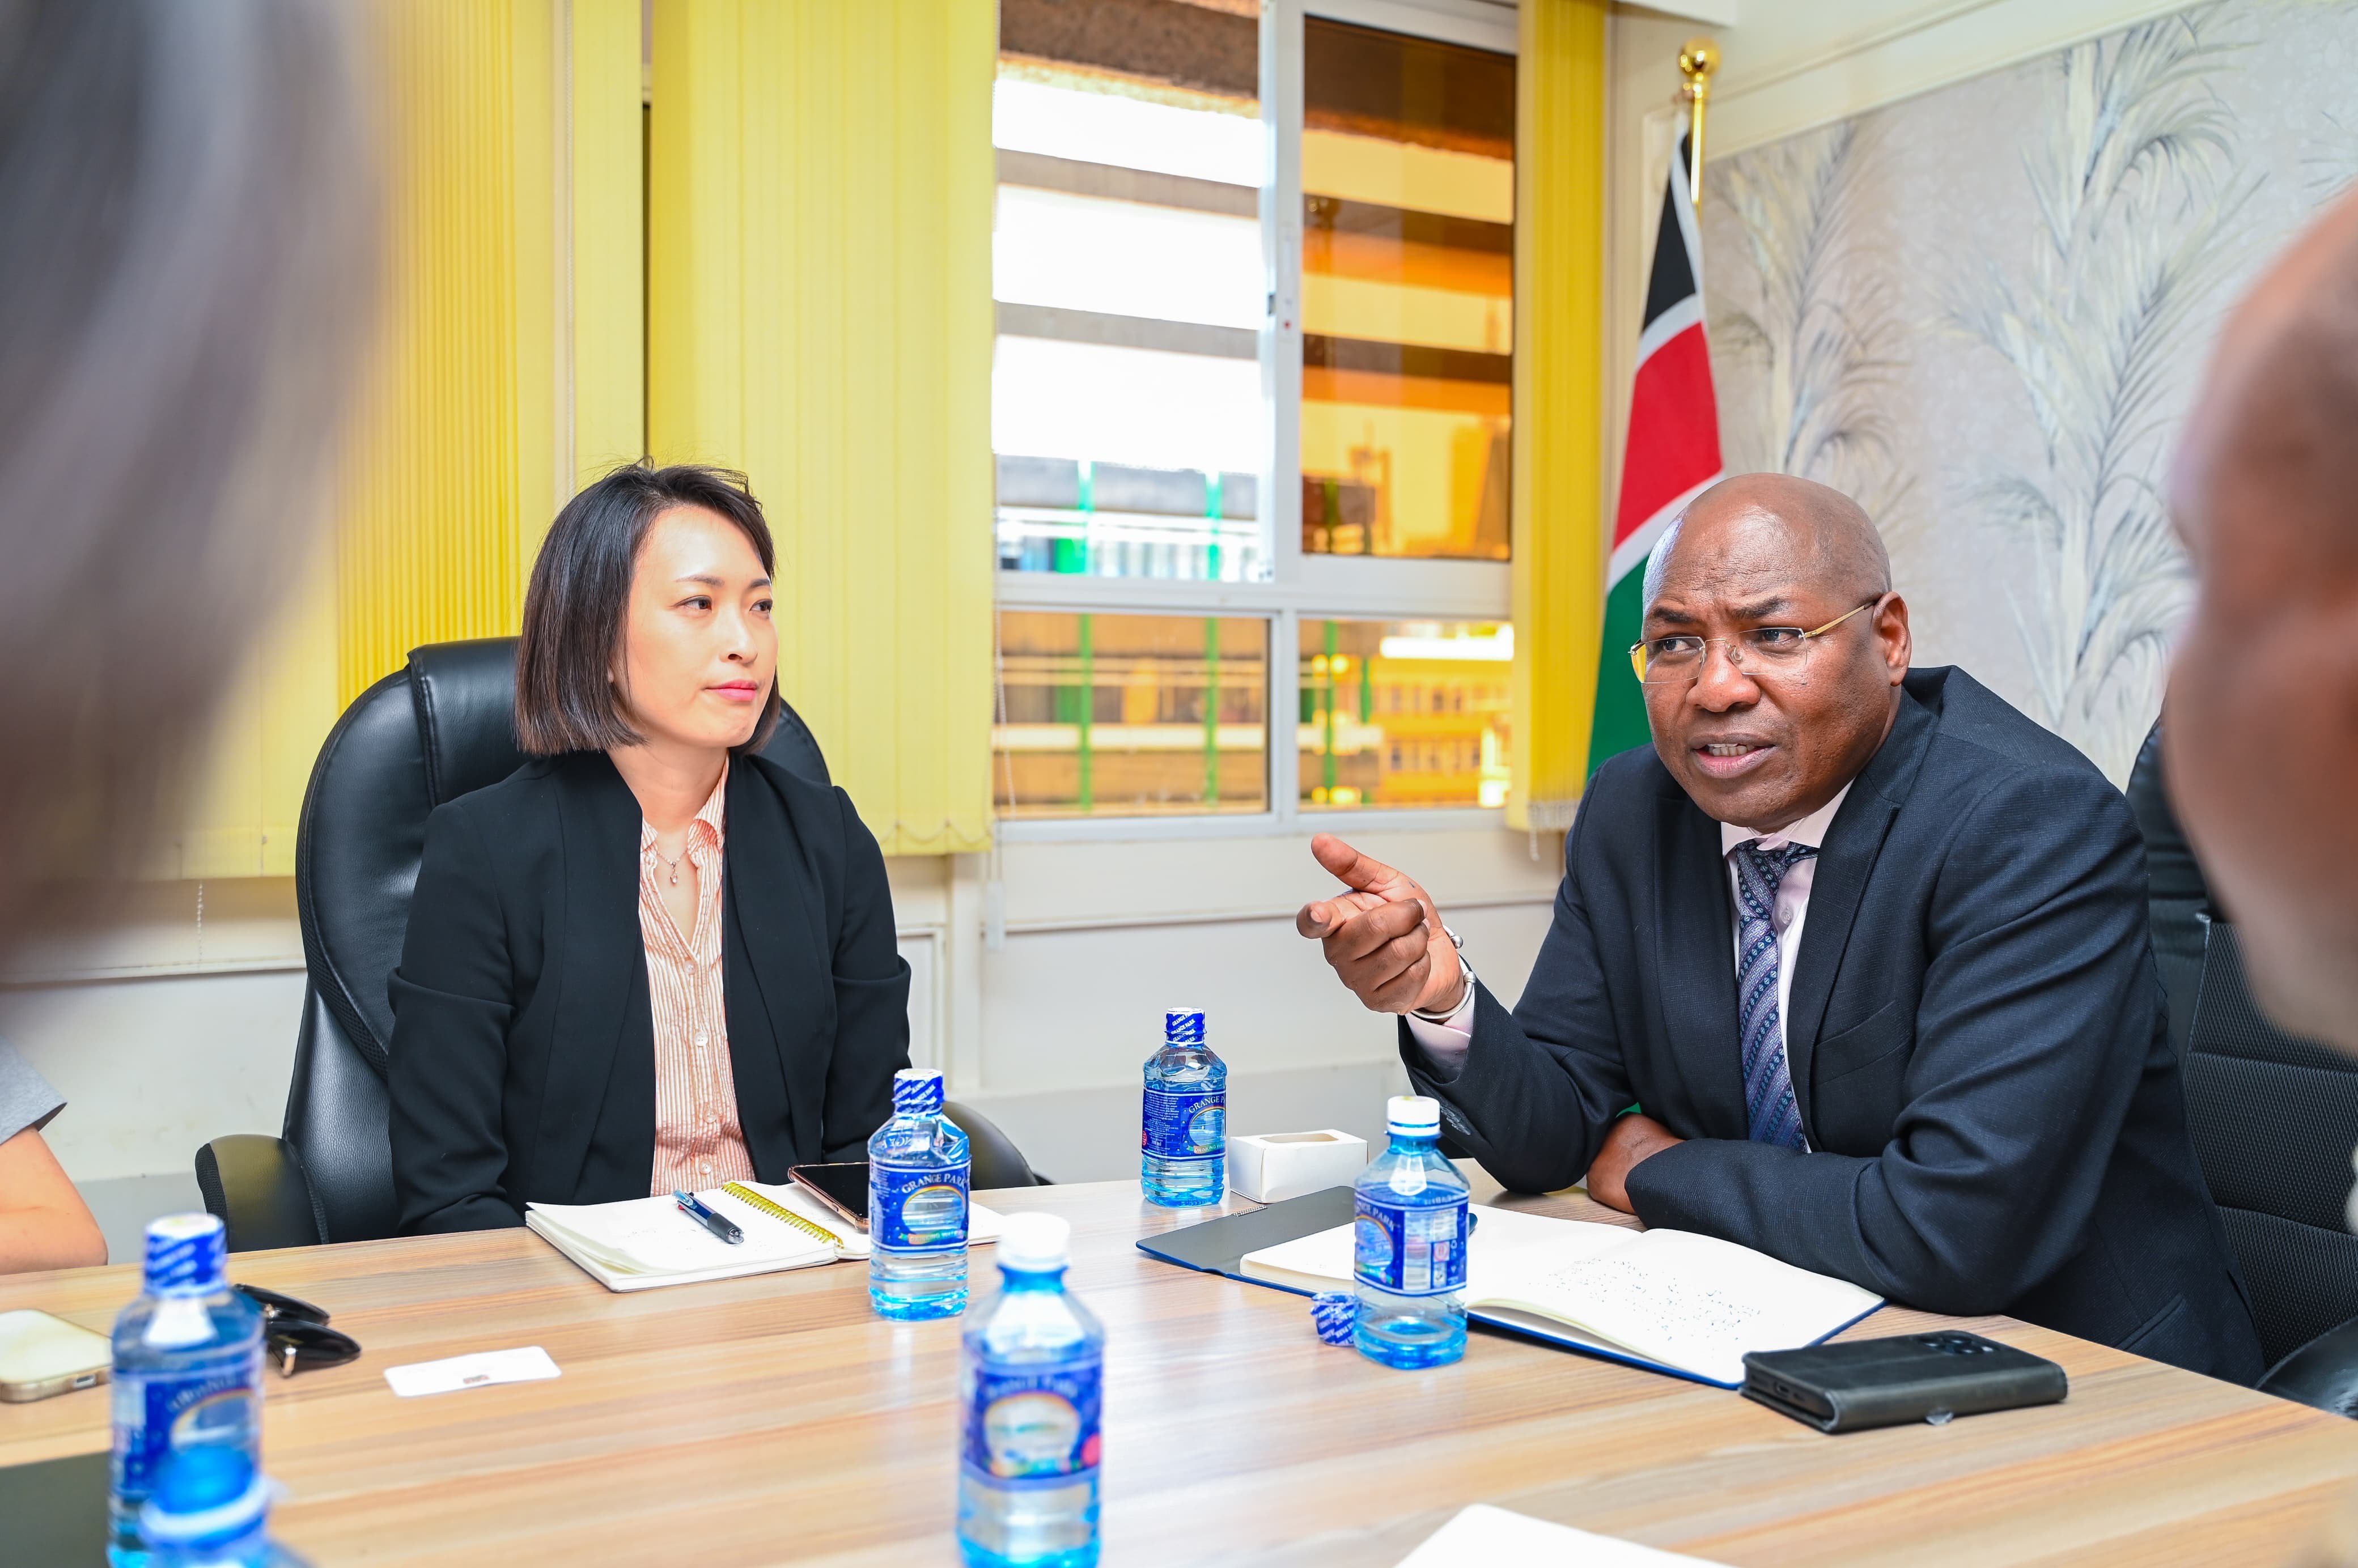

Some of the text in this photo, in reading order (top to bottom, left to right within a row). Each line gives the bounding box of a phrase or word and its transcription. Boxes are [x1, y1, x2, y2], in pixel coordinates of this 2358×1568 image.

[1185, 1018, 1195, 1028] PARK
[1189, 1096, 1220, 1114] GRANGE
[1194, 1142, 1216, 1153] DRINKING
[901, 1174, 941, 1193] GRANGE
[943, 1173, 966, 1189] PARK
